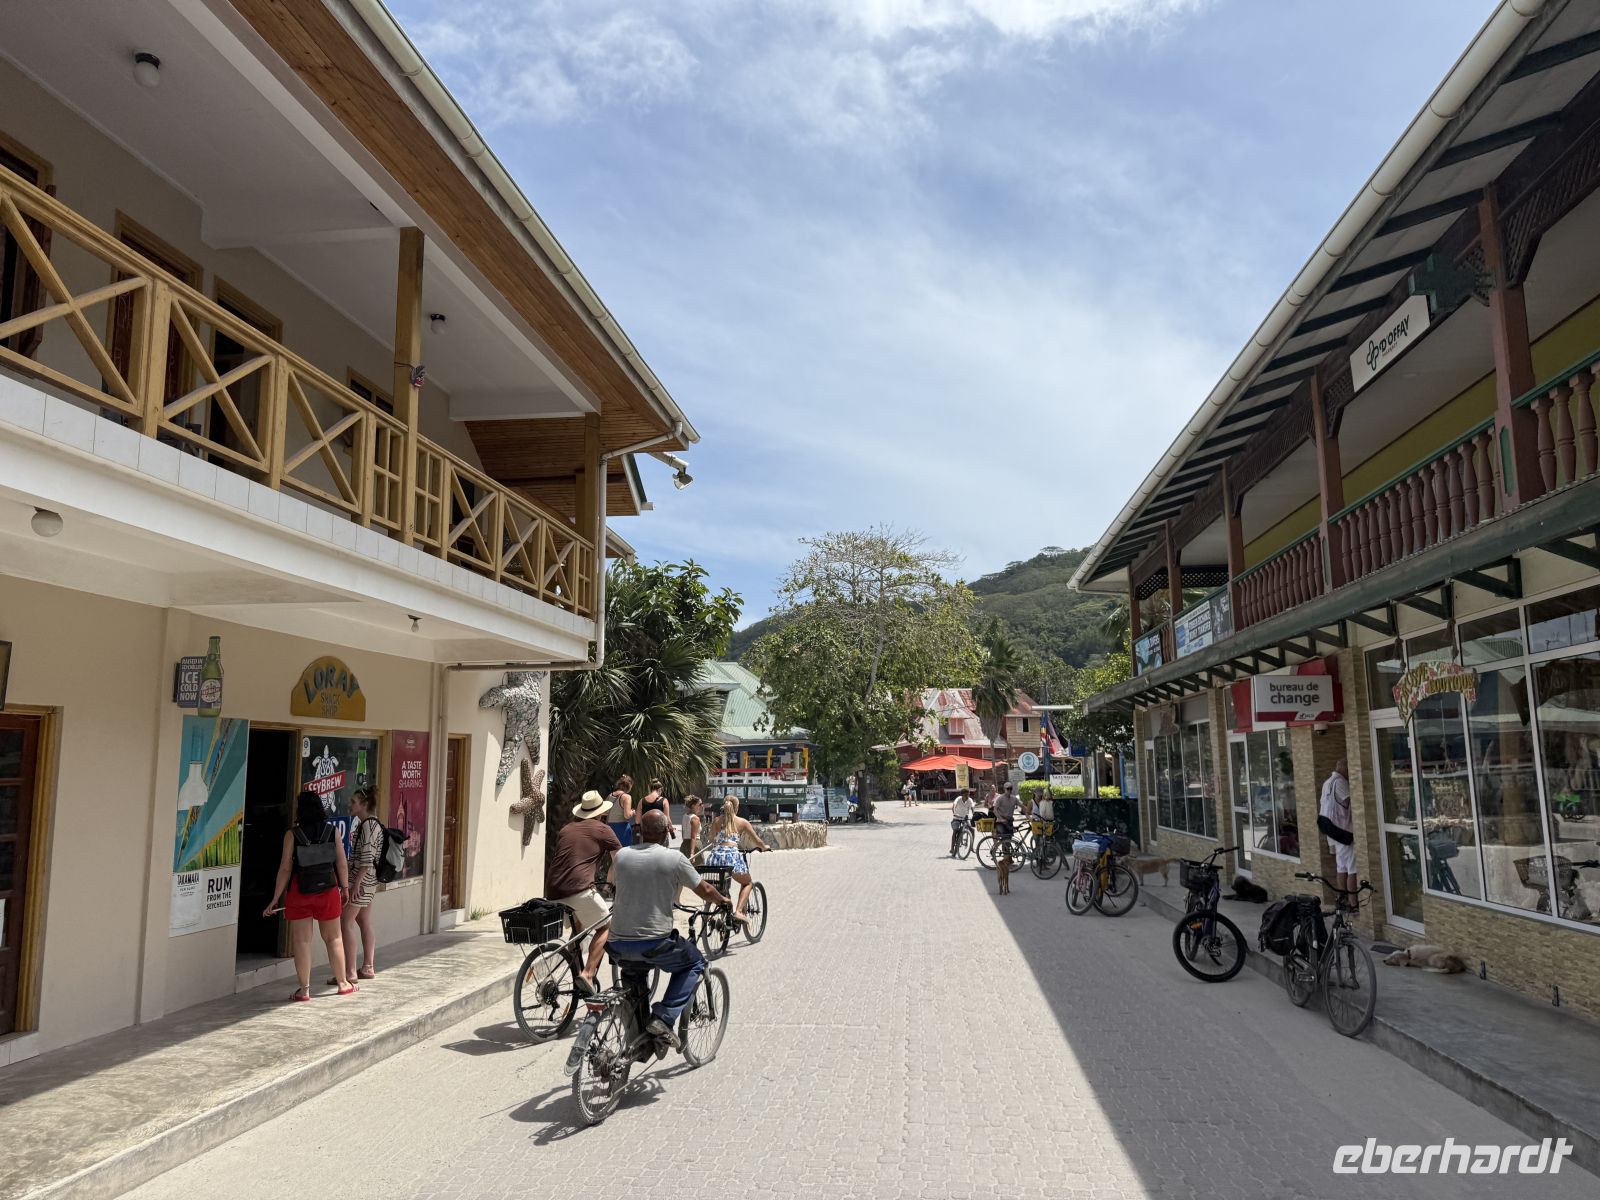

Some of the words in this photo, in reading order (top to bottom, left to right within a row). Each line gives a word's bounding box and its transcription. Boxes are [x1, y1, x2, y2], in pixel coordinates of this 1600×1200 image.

[1379, 314, 1410, 352] D'OFFAY
[181, 671, 199, 683] ICE
[180, 683, 198, 692] COLD
[1269, 682, 1304, 692] bureau
[1306, 682, 1319, 691] de
[179, 692, 197, 701] NOW
[1270, 691, 1320, 706] change
[407, 760, 422, 770] TASTE
[401, 770, 421, 779] WORTH
[207, 875, 233, 894] RUM
[206, 894, 222, 902] FROM
[222, 891, 232, 900] THE
[206, 899, 232, 910] SEYCHELLES
